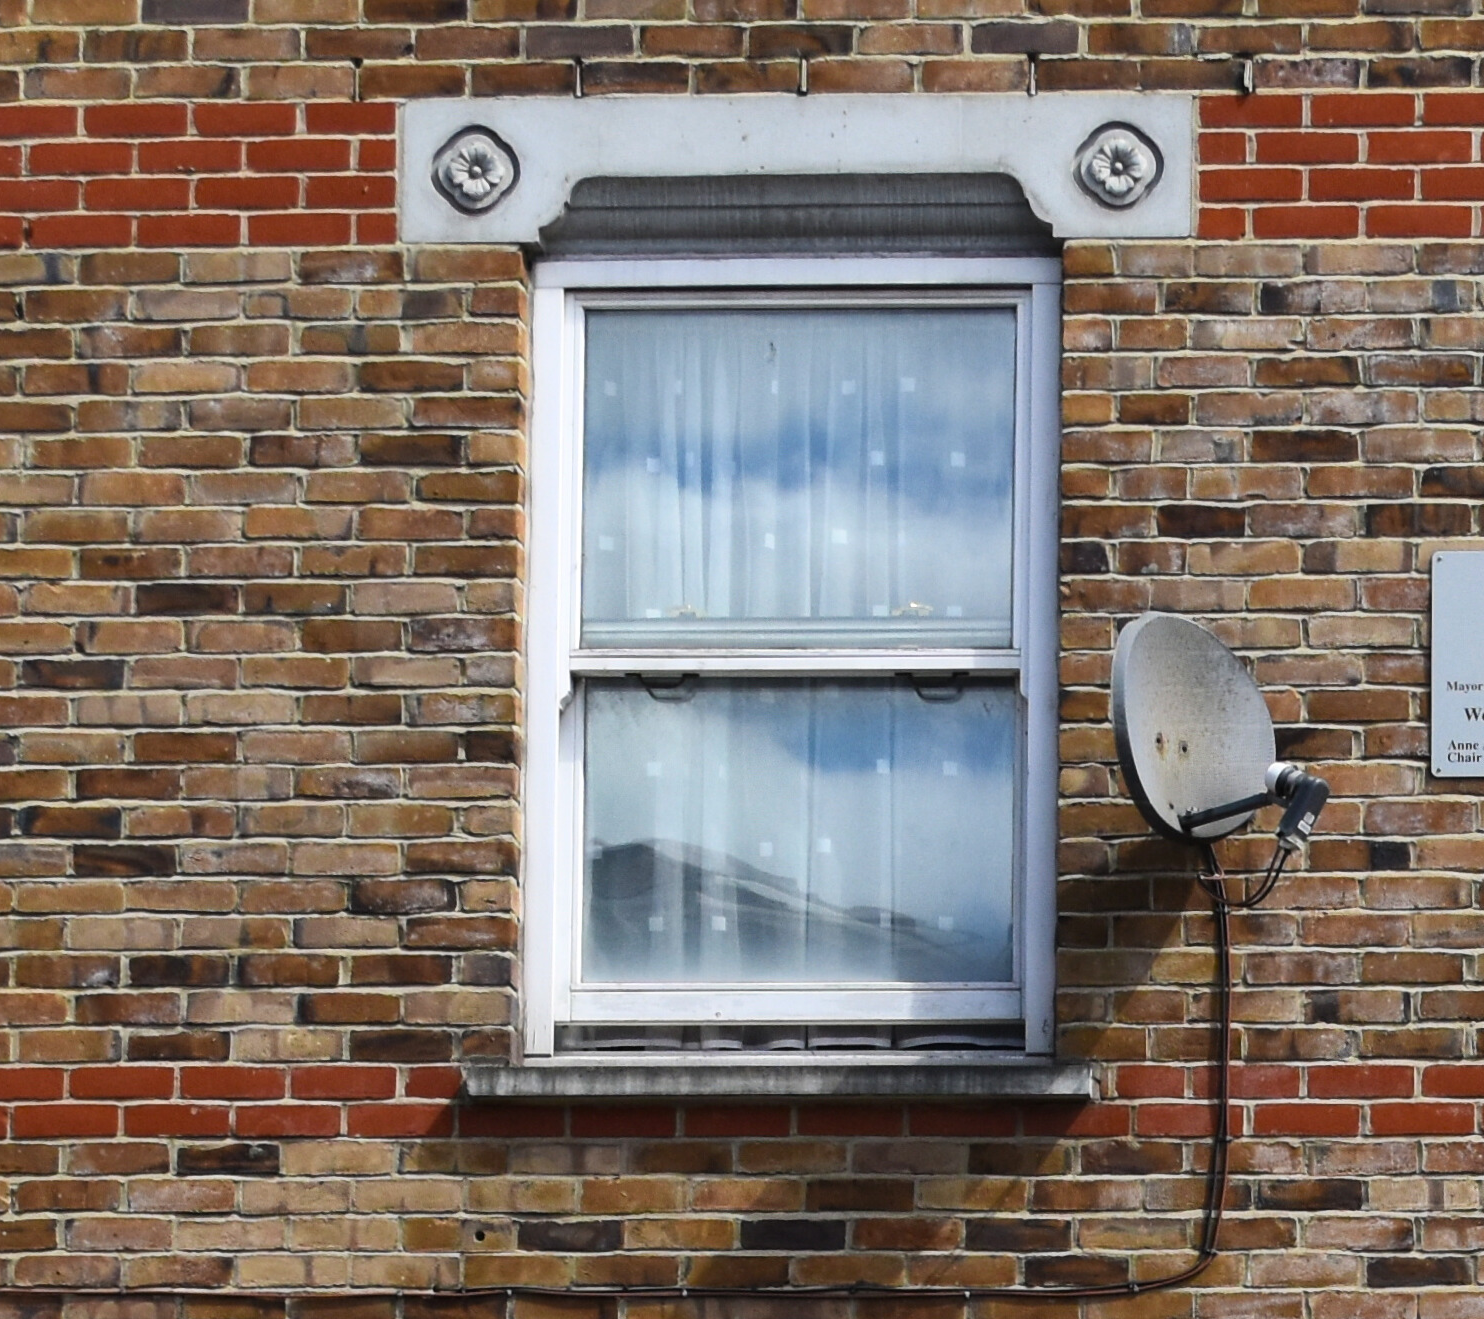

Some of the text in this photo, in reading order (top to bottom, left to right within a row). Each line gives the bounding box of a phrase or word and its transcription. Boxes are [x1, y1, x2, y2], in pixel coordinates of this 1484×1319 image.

[1446, 681, 1484, 694] Mayor
[1448, 739, 1480, 751] Anne
[1447, 752, 1483, 764] Chair
